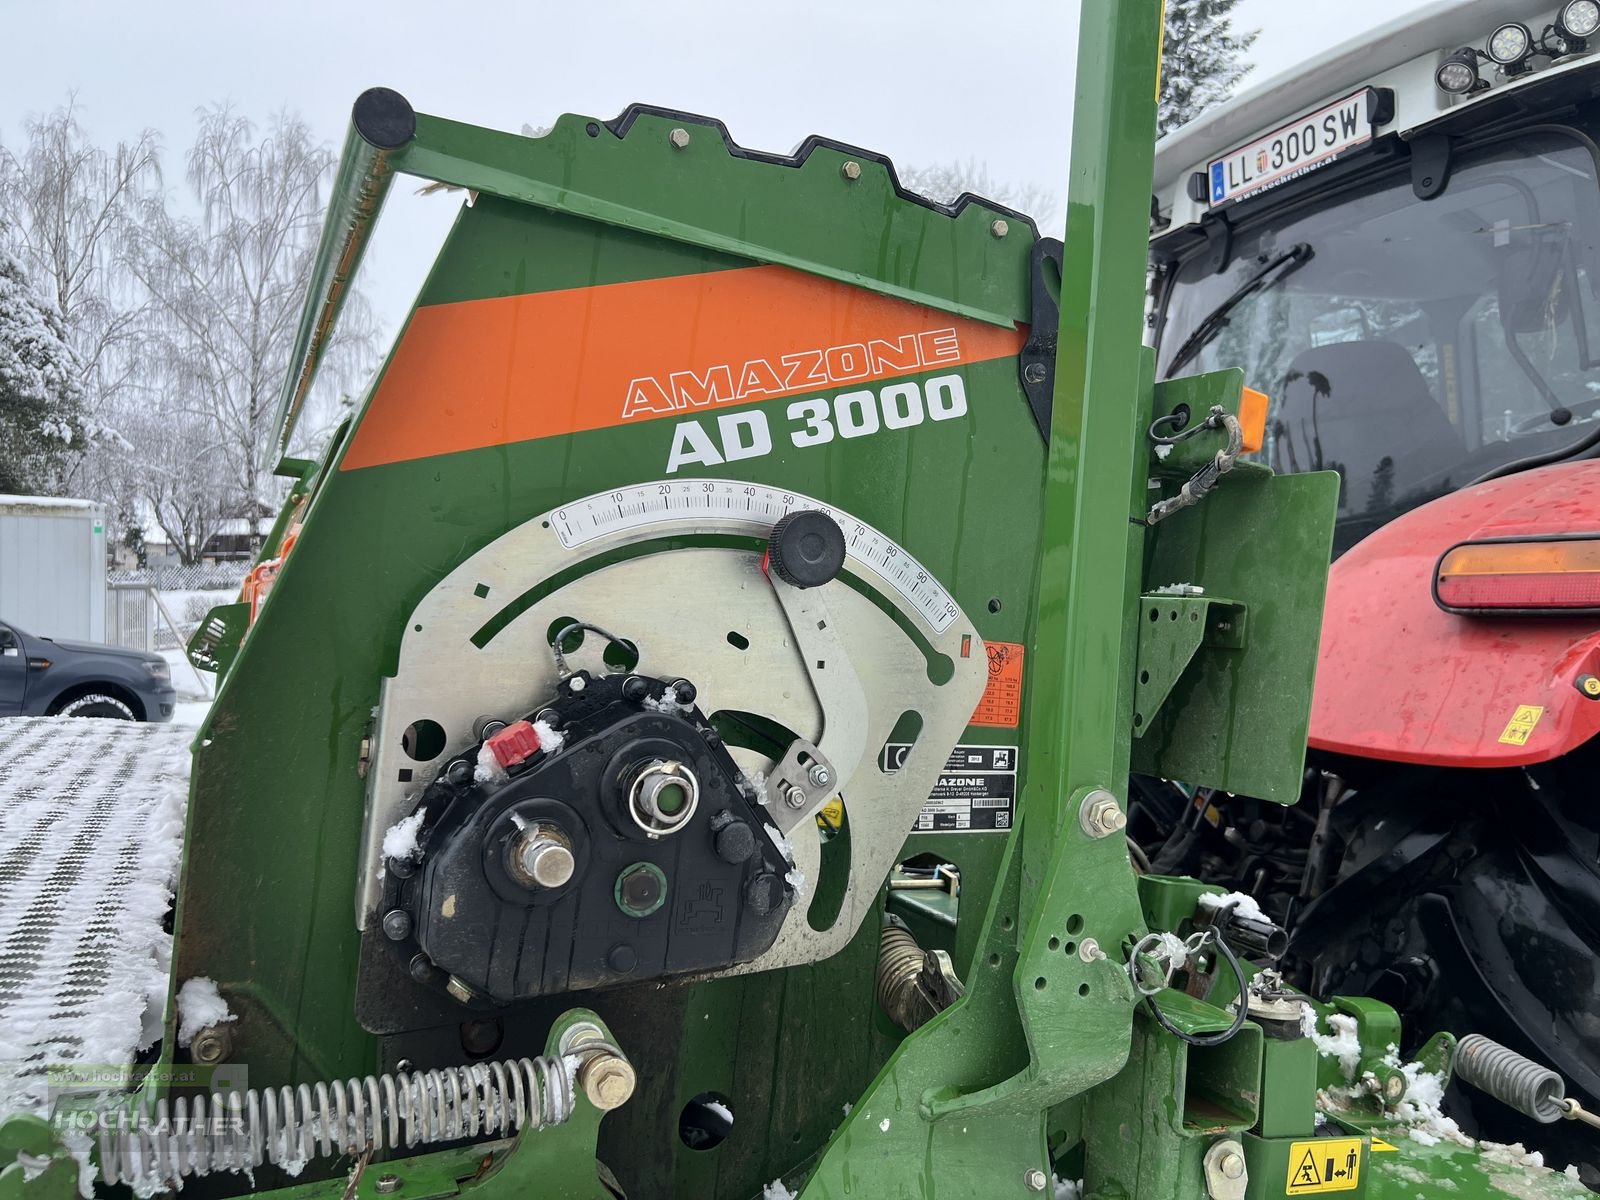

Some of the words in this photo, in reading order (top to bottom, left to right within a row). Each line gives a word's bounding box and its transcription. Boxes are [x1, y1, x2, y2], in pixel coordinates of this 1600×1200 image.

[1229, 156, 1253, 190] LL
[1271, 125, 1316, 169] 300
[1323, 103, 1358, 147] SW
[1234, 154, 1338, 202] www.hochrather.at
[1215, 186, 1223, 196] A
[622, 328, 961, 418] AMAZONE
[665, 409, 773, 474] AD
[786, 374, 968, 448] 3000
[610, 492, 624, 503] 10
[658, 485, 671, 495] 20
[702, 483, 715, 493] 30
[744, 487, 756, 497] 40
[782, 494, 794, 506] 50
[820, 507, 832, 516] 60
[854, 524, 865, 536] 70
[886, 545, 897, 557] 80
[916, 571, 928, 584] 90
[944, 602, 957, 618] 100
